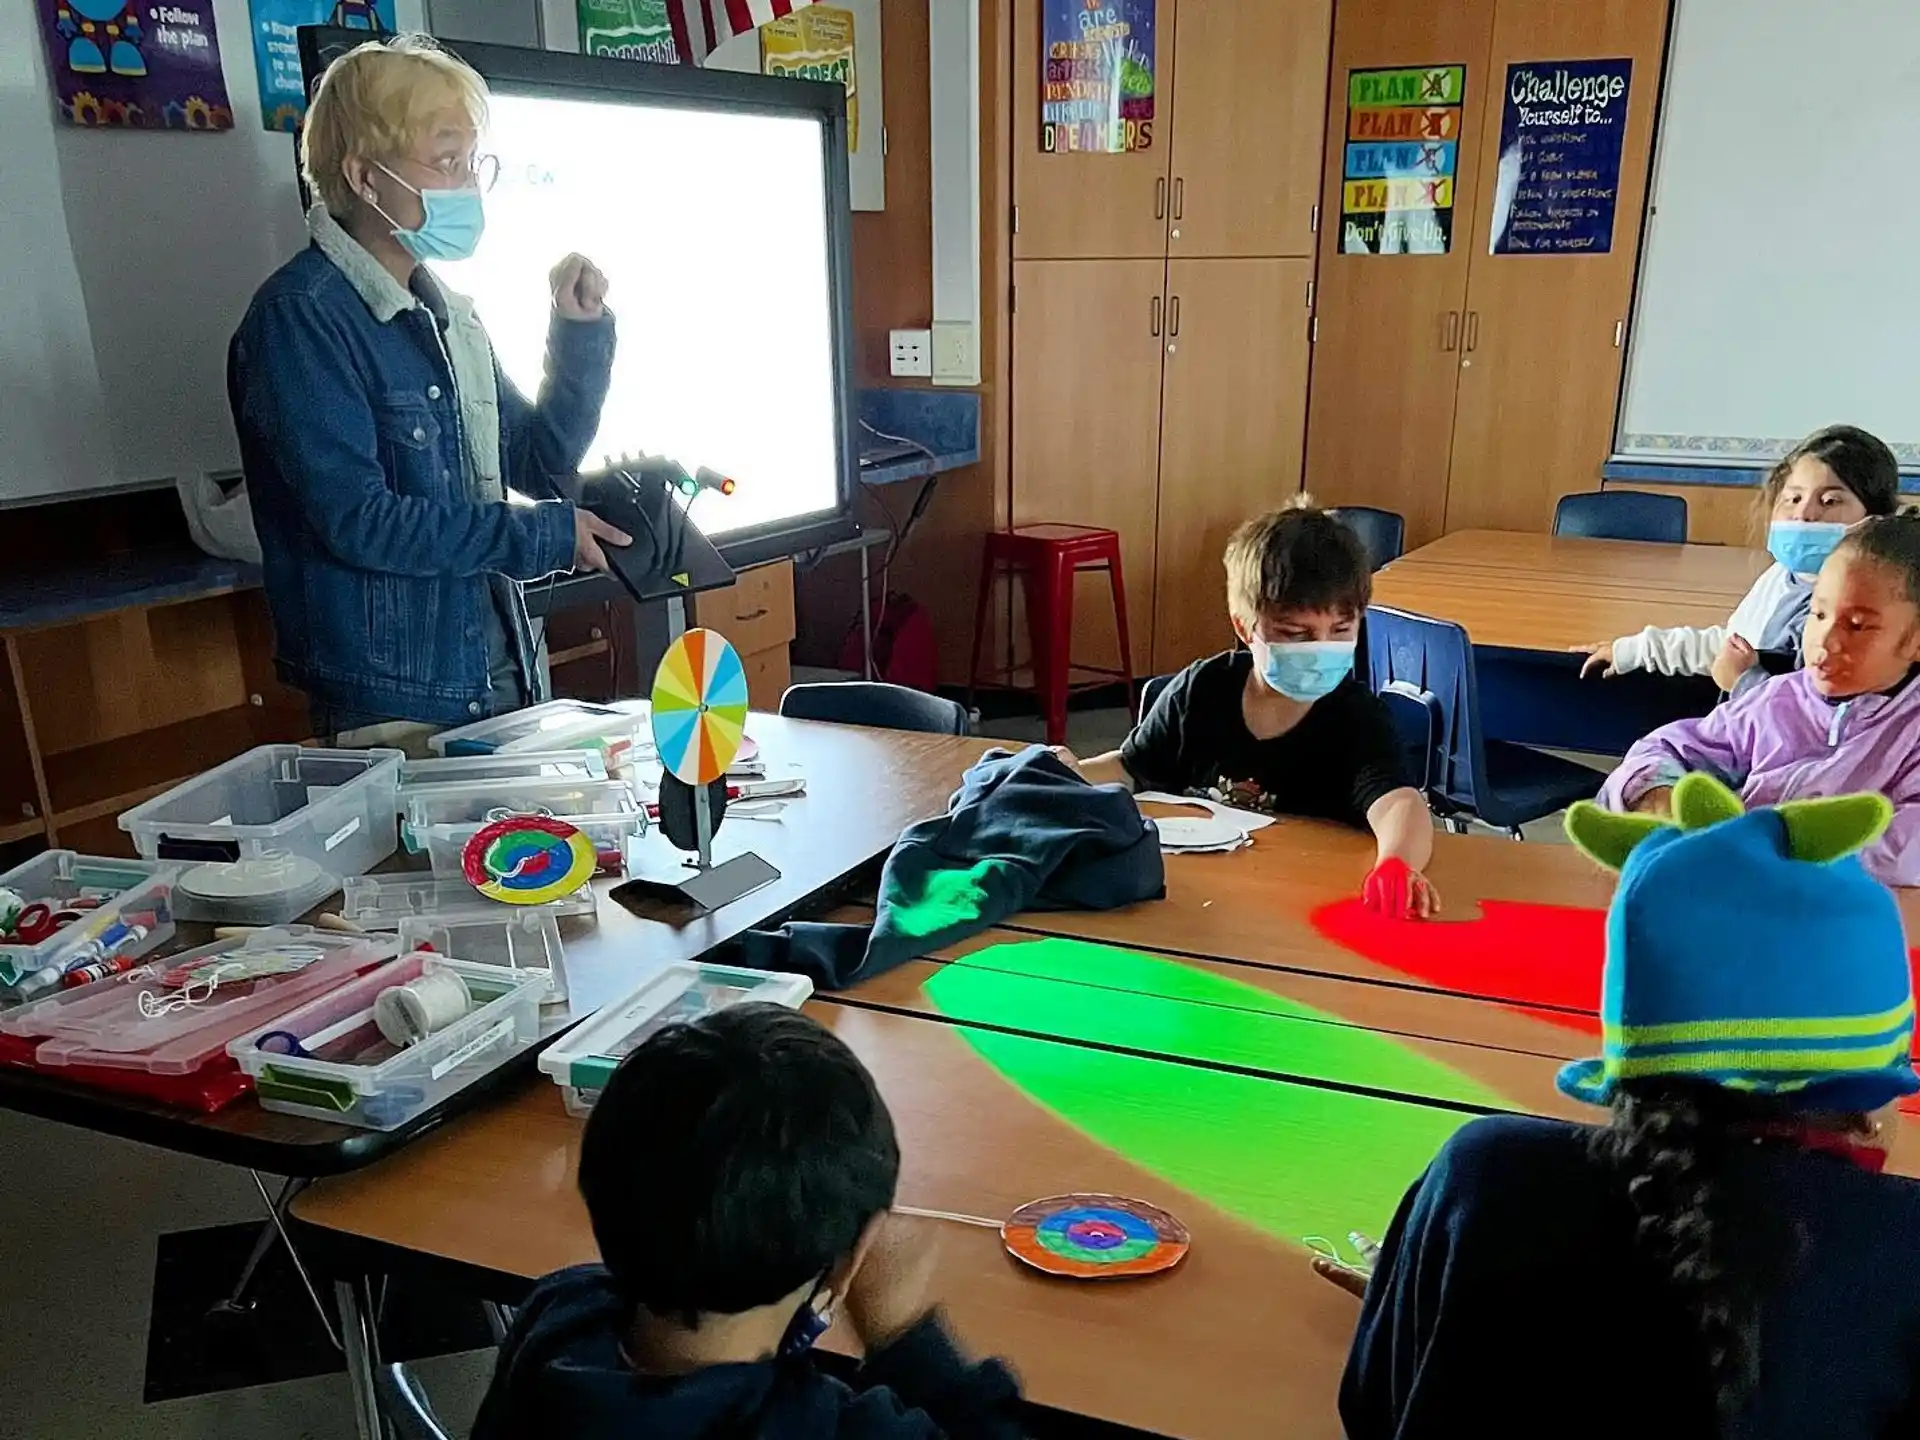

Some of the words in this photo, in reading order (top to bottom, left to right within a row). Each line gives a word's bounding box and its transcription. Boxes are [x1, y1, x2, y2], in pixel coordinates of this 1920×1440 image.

[158, 6, 200, 26] Follow
[1078, 8, 1117, 31] are
[157, 24, 178, 44] the
[181, 29, 209, 50] plan
[1358, 74, 1417, 101] PLAN
[1511, 70, 1625, 108] Challenge
[1357, 111, 1414, 137] PLAN
[1518, 104, 1584, 127] Yourself
[1354, 146, 1412, 172] PLAN
[1353, 184, 1408, 209] PLAN
[1344, 220, 1385, 242] Don't
